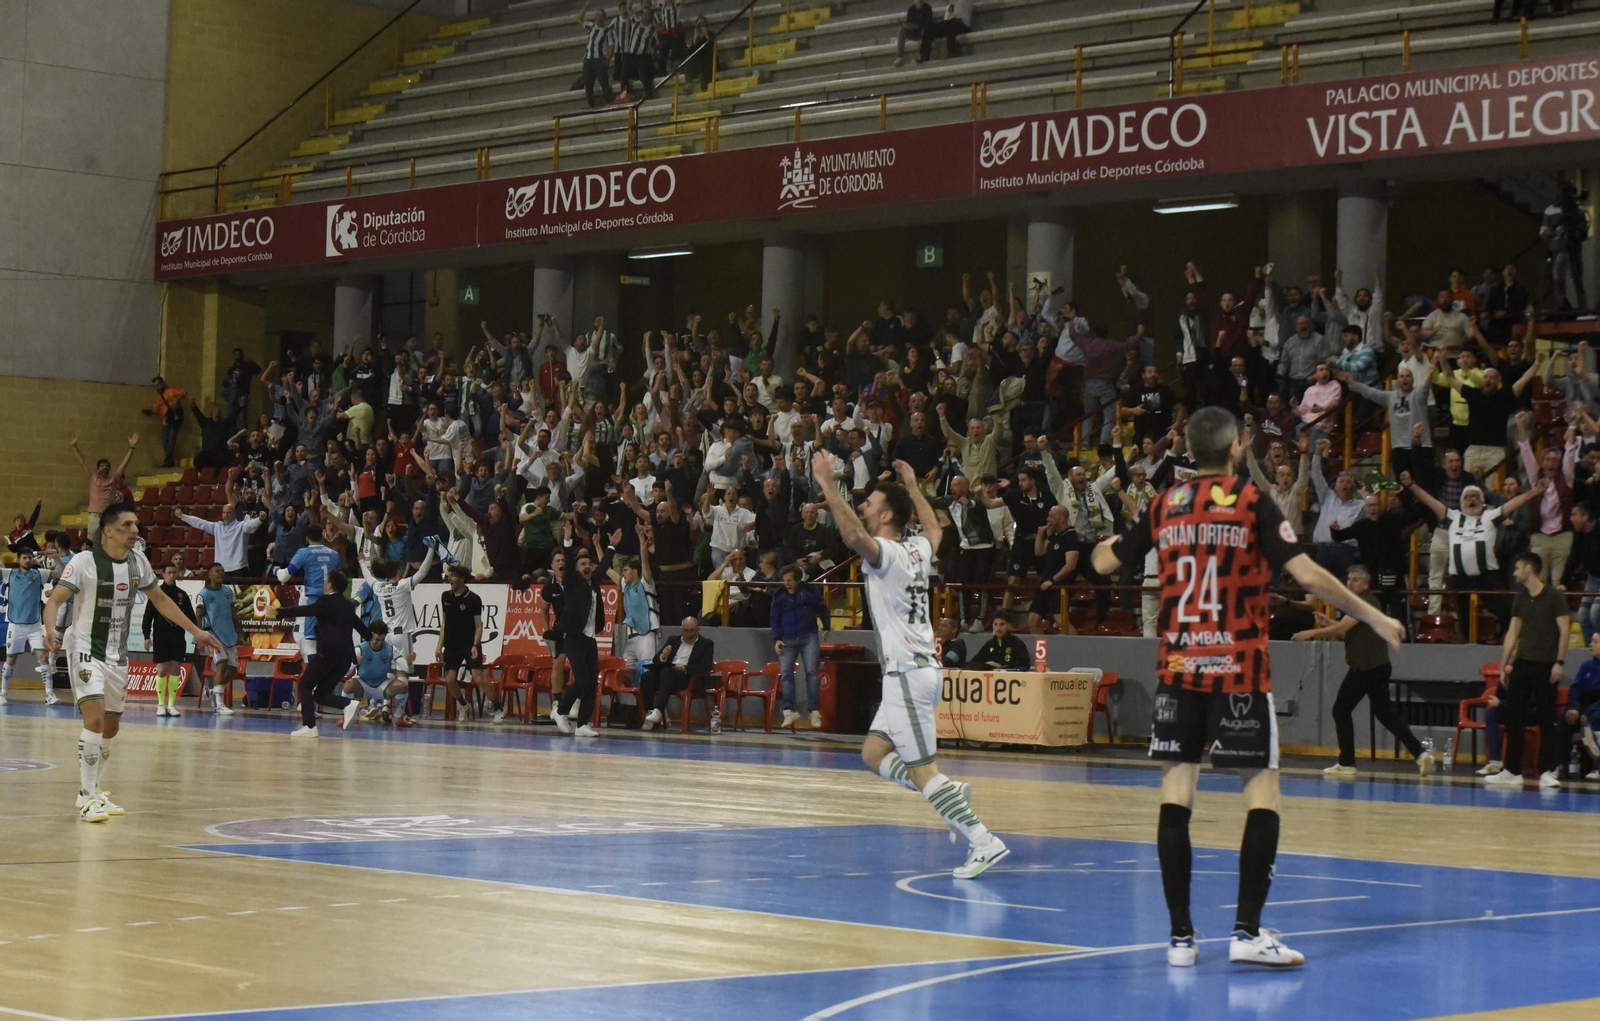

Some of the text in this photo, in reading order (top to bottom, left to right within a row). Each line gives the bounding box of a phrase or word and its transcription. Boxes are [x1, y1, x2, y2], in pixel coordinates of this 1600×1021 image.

[1325, 61, 1599, 106] PALACIO MUNICIPAL DEPORTES
[1030, 103, 1207, 162] IMDECO
[1306, 89, 1600, 158] VISTA ALEGR
[819, 148, 896, 173] AYUNTAMIENTO
[819, 172, 884, 196] DE CÓRDOBA
[980, 157, 1204, 190] Instituto Municipal de Deportes Córdoba
[543, 164, 676, 215] IMDECO
[363, 206, 425, 231] Diputación
[505, 211, 674, 239] Instituto Municipal de Deportes Córdoba
[186, 216, 275, 253] IMDECO
[362, 226, 426, 247] de Córdoba
[160, 252, 273, 272] Instituto Municipal de Deportes Córdoba
[924, 245, 936, 264] B
[464, 285, 475, 301] A
[1198, 523, 1249, 549] ORTEGO
[1176, 555, 1223, 623] 24
[384, 599, 396, 618] 5
[524, 606, 533, 614] del
[1035, 640, 1047, 659] 5
[1179, 631, 1235, 646] AMBAR
[938, 711, 1000, 723] avanzamos al futuro
[259, 821, 723, 841] IMDECO
